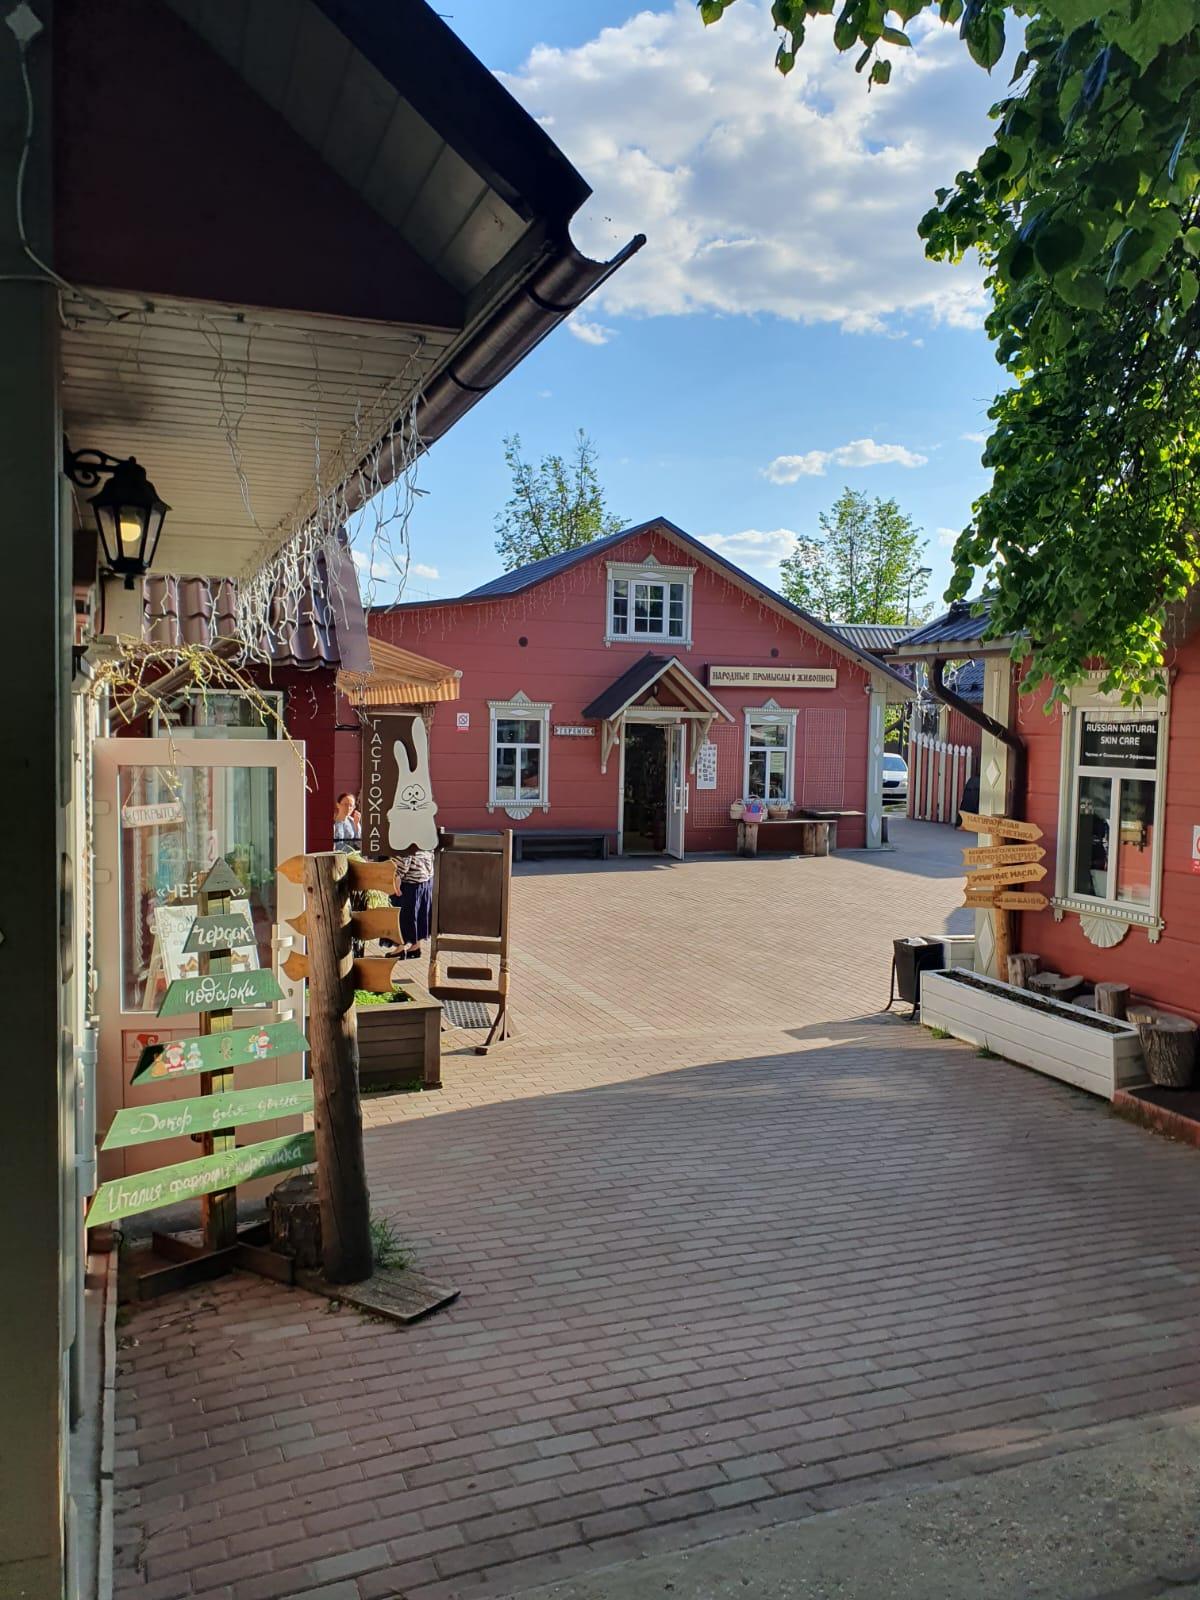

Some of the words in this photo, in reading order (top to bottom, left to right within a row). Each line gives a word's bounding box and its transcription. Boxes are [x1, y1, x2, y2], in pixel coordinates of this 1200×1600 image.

[712, 671, 750, 682] НАРОДНЫЕ
[752, 672, 791, 682] ПРОМЫСЛЫ
[797, 673, 835, 682] ЖИВОПИСЬ
[1086, 722, 1118, 733] RUSSIAN
[1119, 724, 1157, 734] NATURAL
[1100, 736, 1118, 745] SKIN
[1119, 736, 1141, 745] CARE
[132, 807, 175, 821] ОТКРЫТО
[969, 851, 1038, 864] ПАРФЮМЕРИЯ
[1010, 868, 1038, 879] МАСЛА
[186, 977, 257, 1006] подарки
[108, 1184, 162, 1213] Италия
